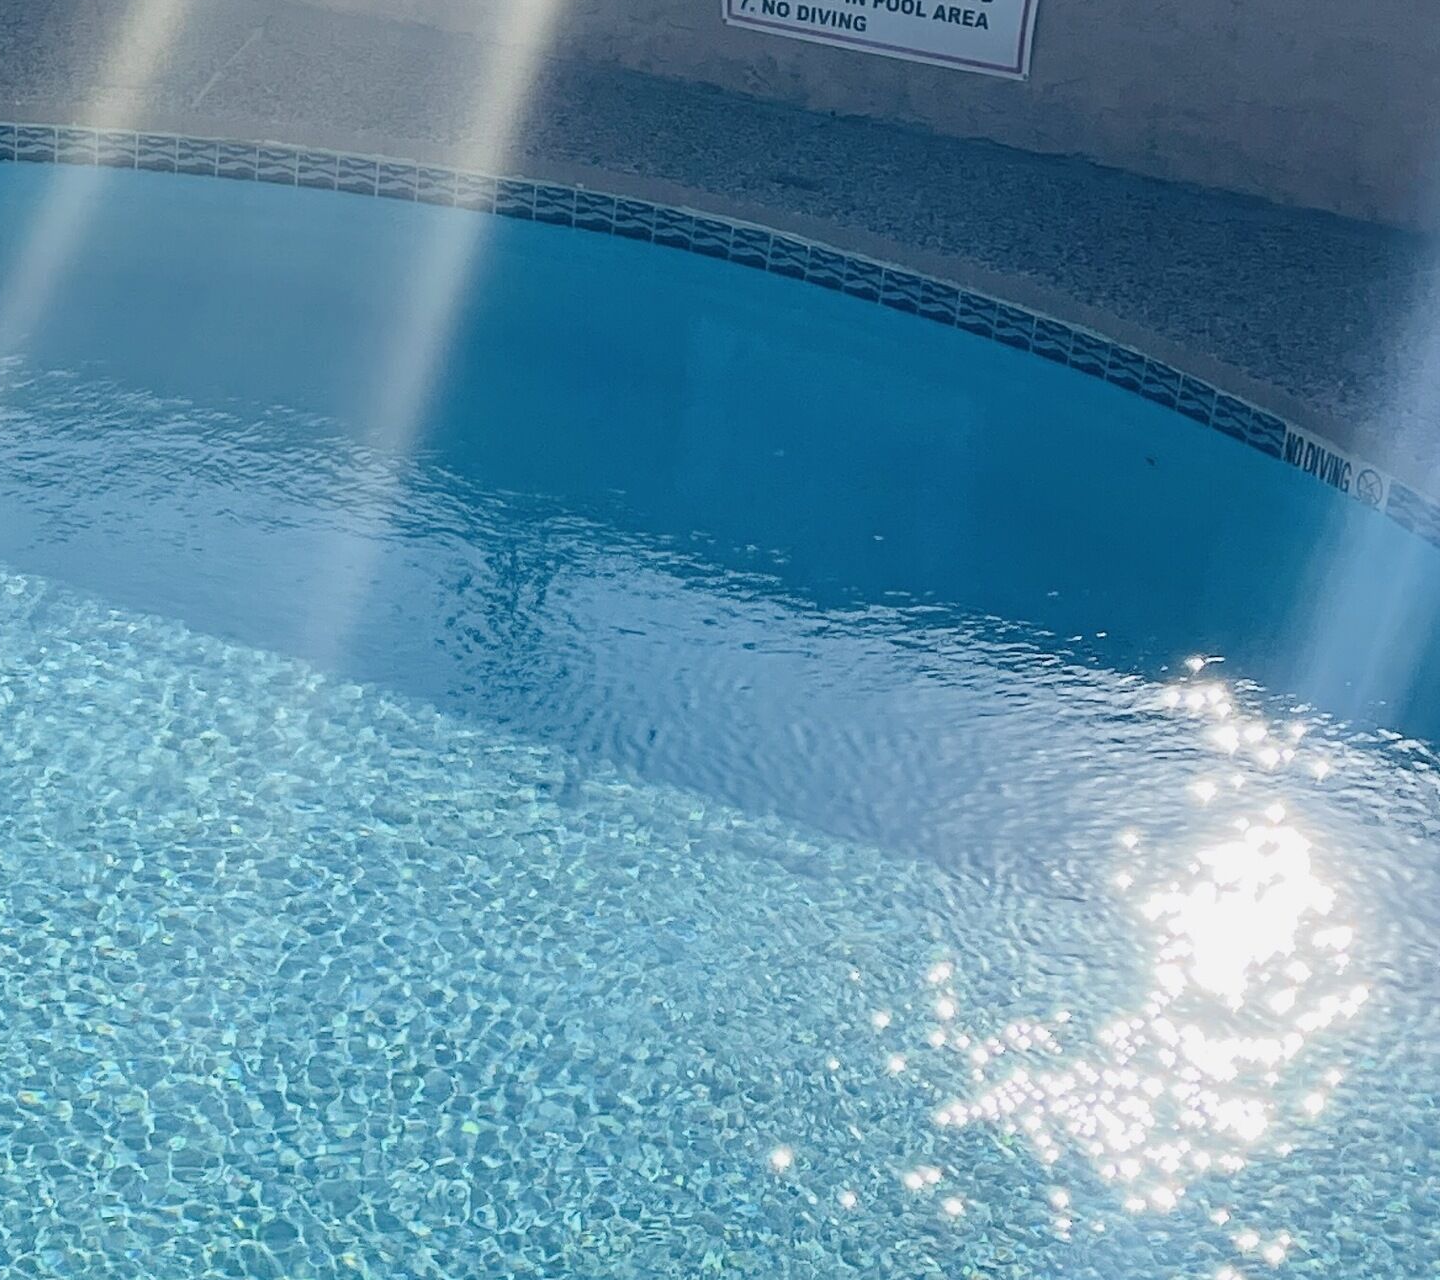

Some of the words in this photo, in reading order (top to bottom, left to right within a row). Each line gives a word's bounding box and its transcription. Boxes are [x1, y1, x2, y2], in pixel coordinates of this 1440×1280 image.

[797, 5, 868, 32] DIVING
[933, 4, 990, 30] AREA
[1284, 431, 1305, 467] NO
[1303, 441, 1353, 493] DIVING
